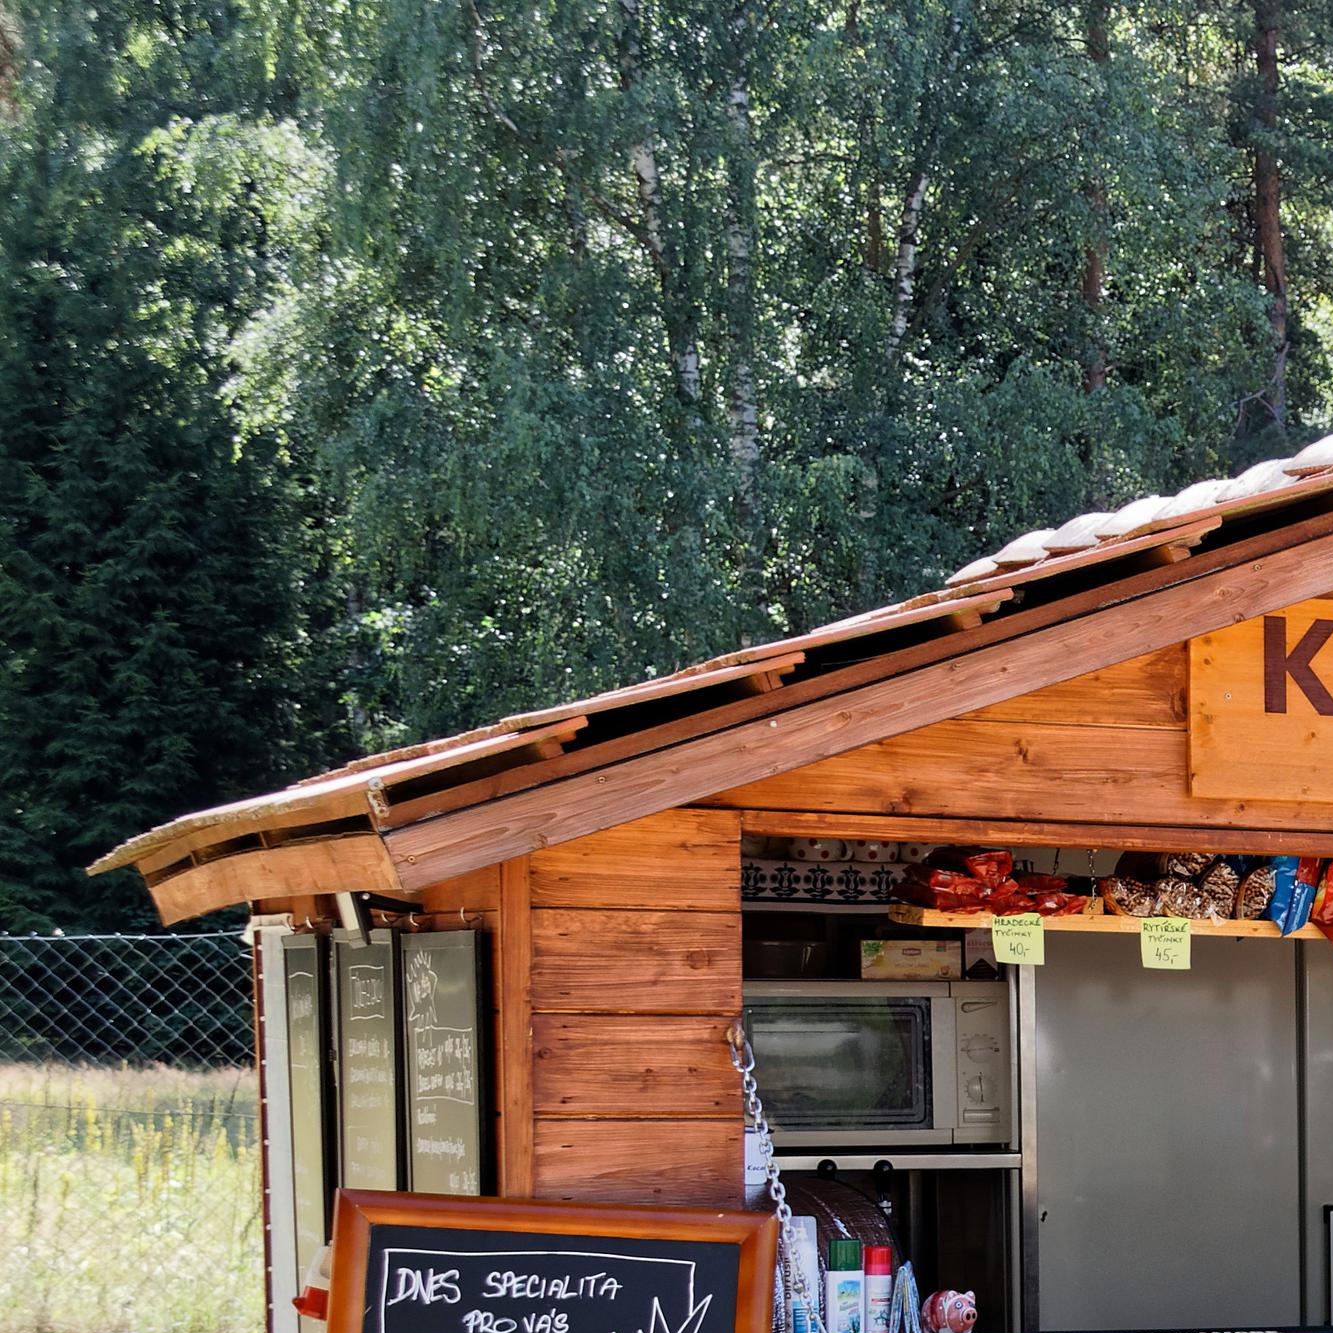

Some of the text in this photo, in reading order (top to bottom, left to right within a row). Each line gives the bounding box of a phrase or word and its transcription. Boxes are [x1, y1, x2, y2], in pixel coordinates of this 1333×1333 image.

[1009, 942, 1031, 957] 40,-
[1155, 946, 1180, 964] 45,-
[387, 1267, 624, 1306] DNES SPECIALITA
